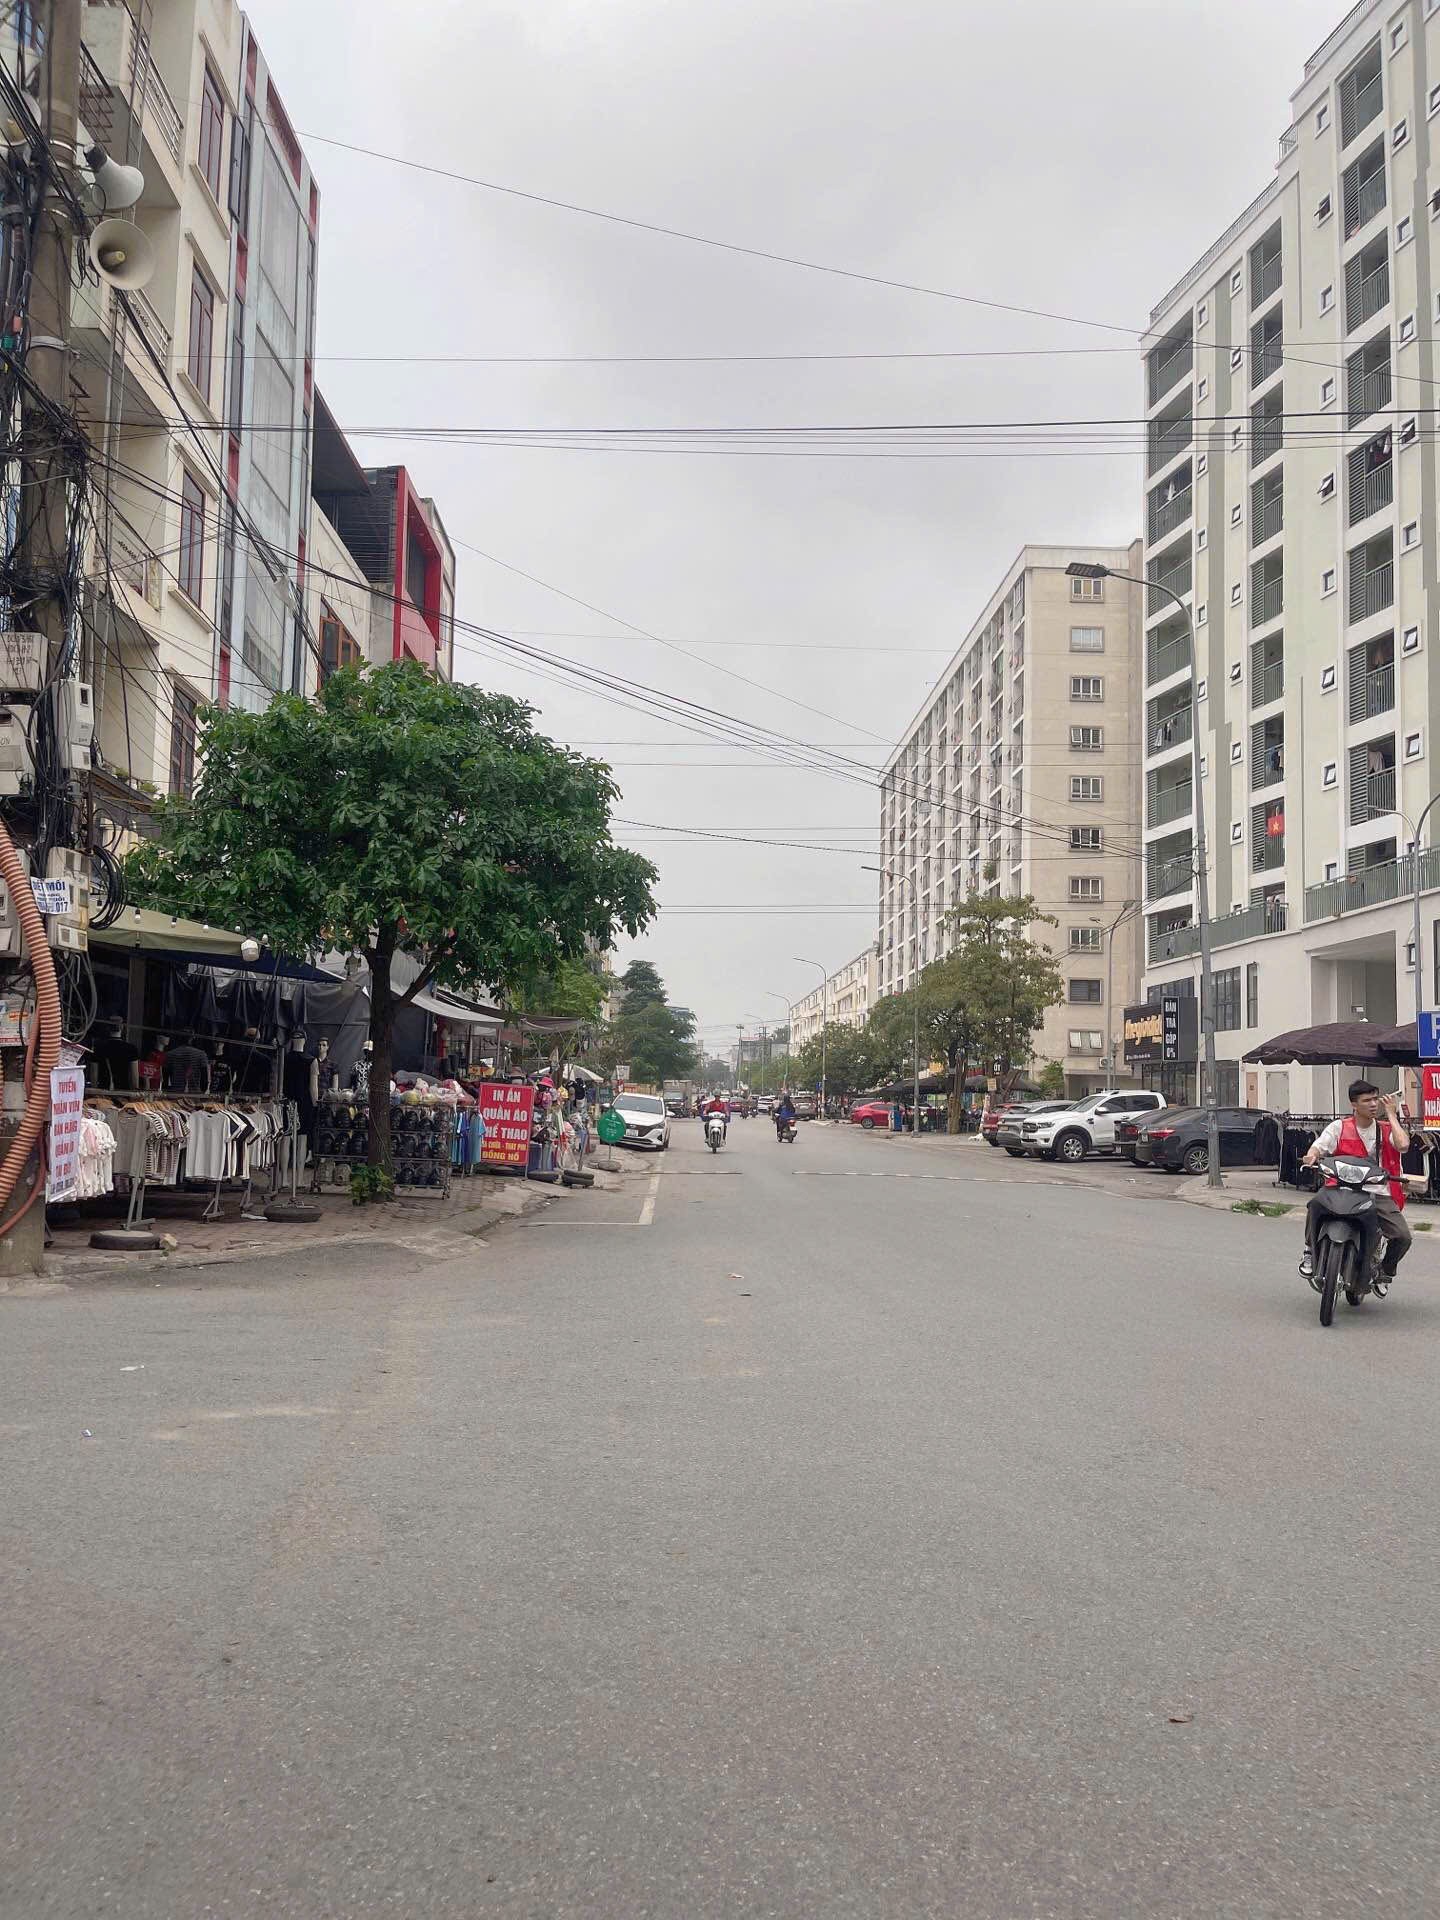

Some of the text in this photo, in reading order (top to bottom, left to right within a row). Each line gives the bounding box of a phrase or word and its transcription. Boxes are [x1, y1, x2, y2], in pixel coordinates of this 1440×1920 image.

[1165, 1000, 1177, 1012] BÁN
[493, 1089, 504, 1101] IN
[500, 1128, 528, 1140] THAO
